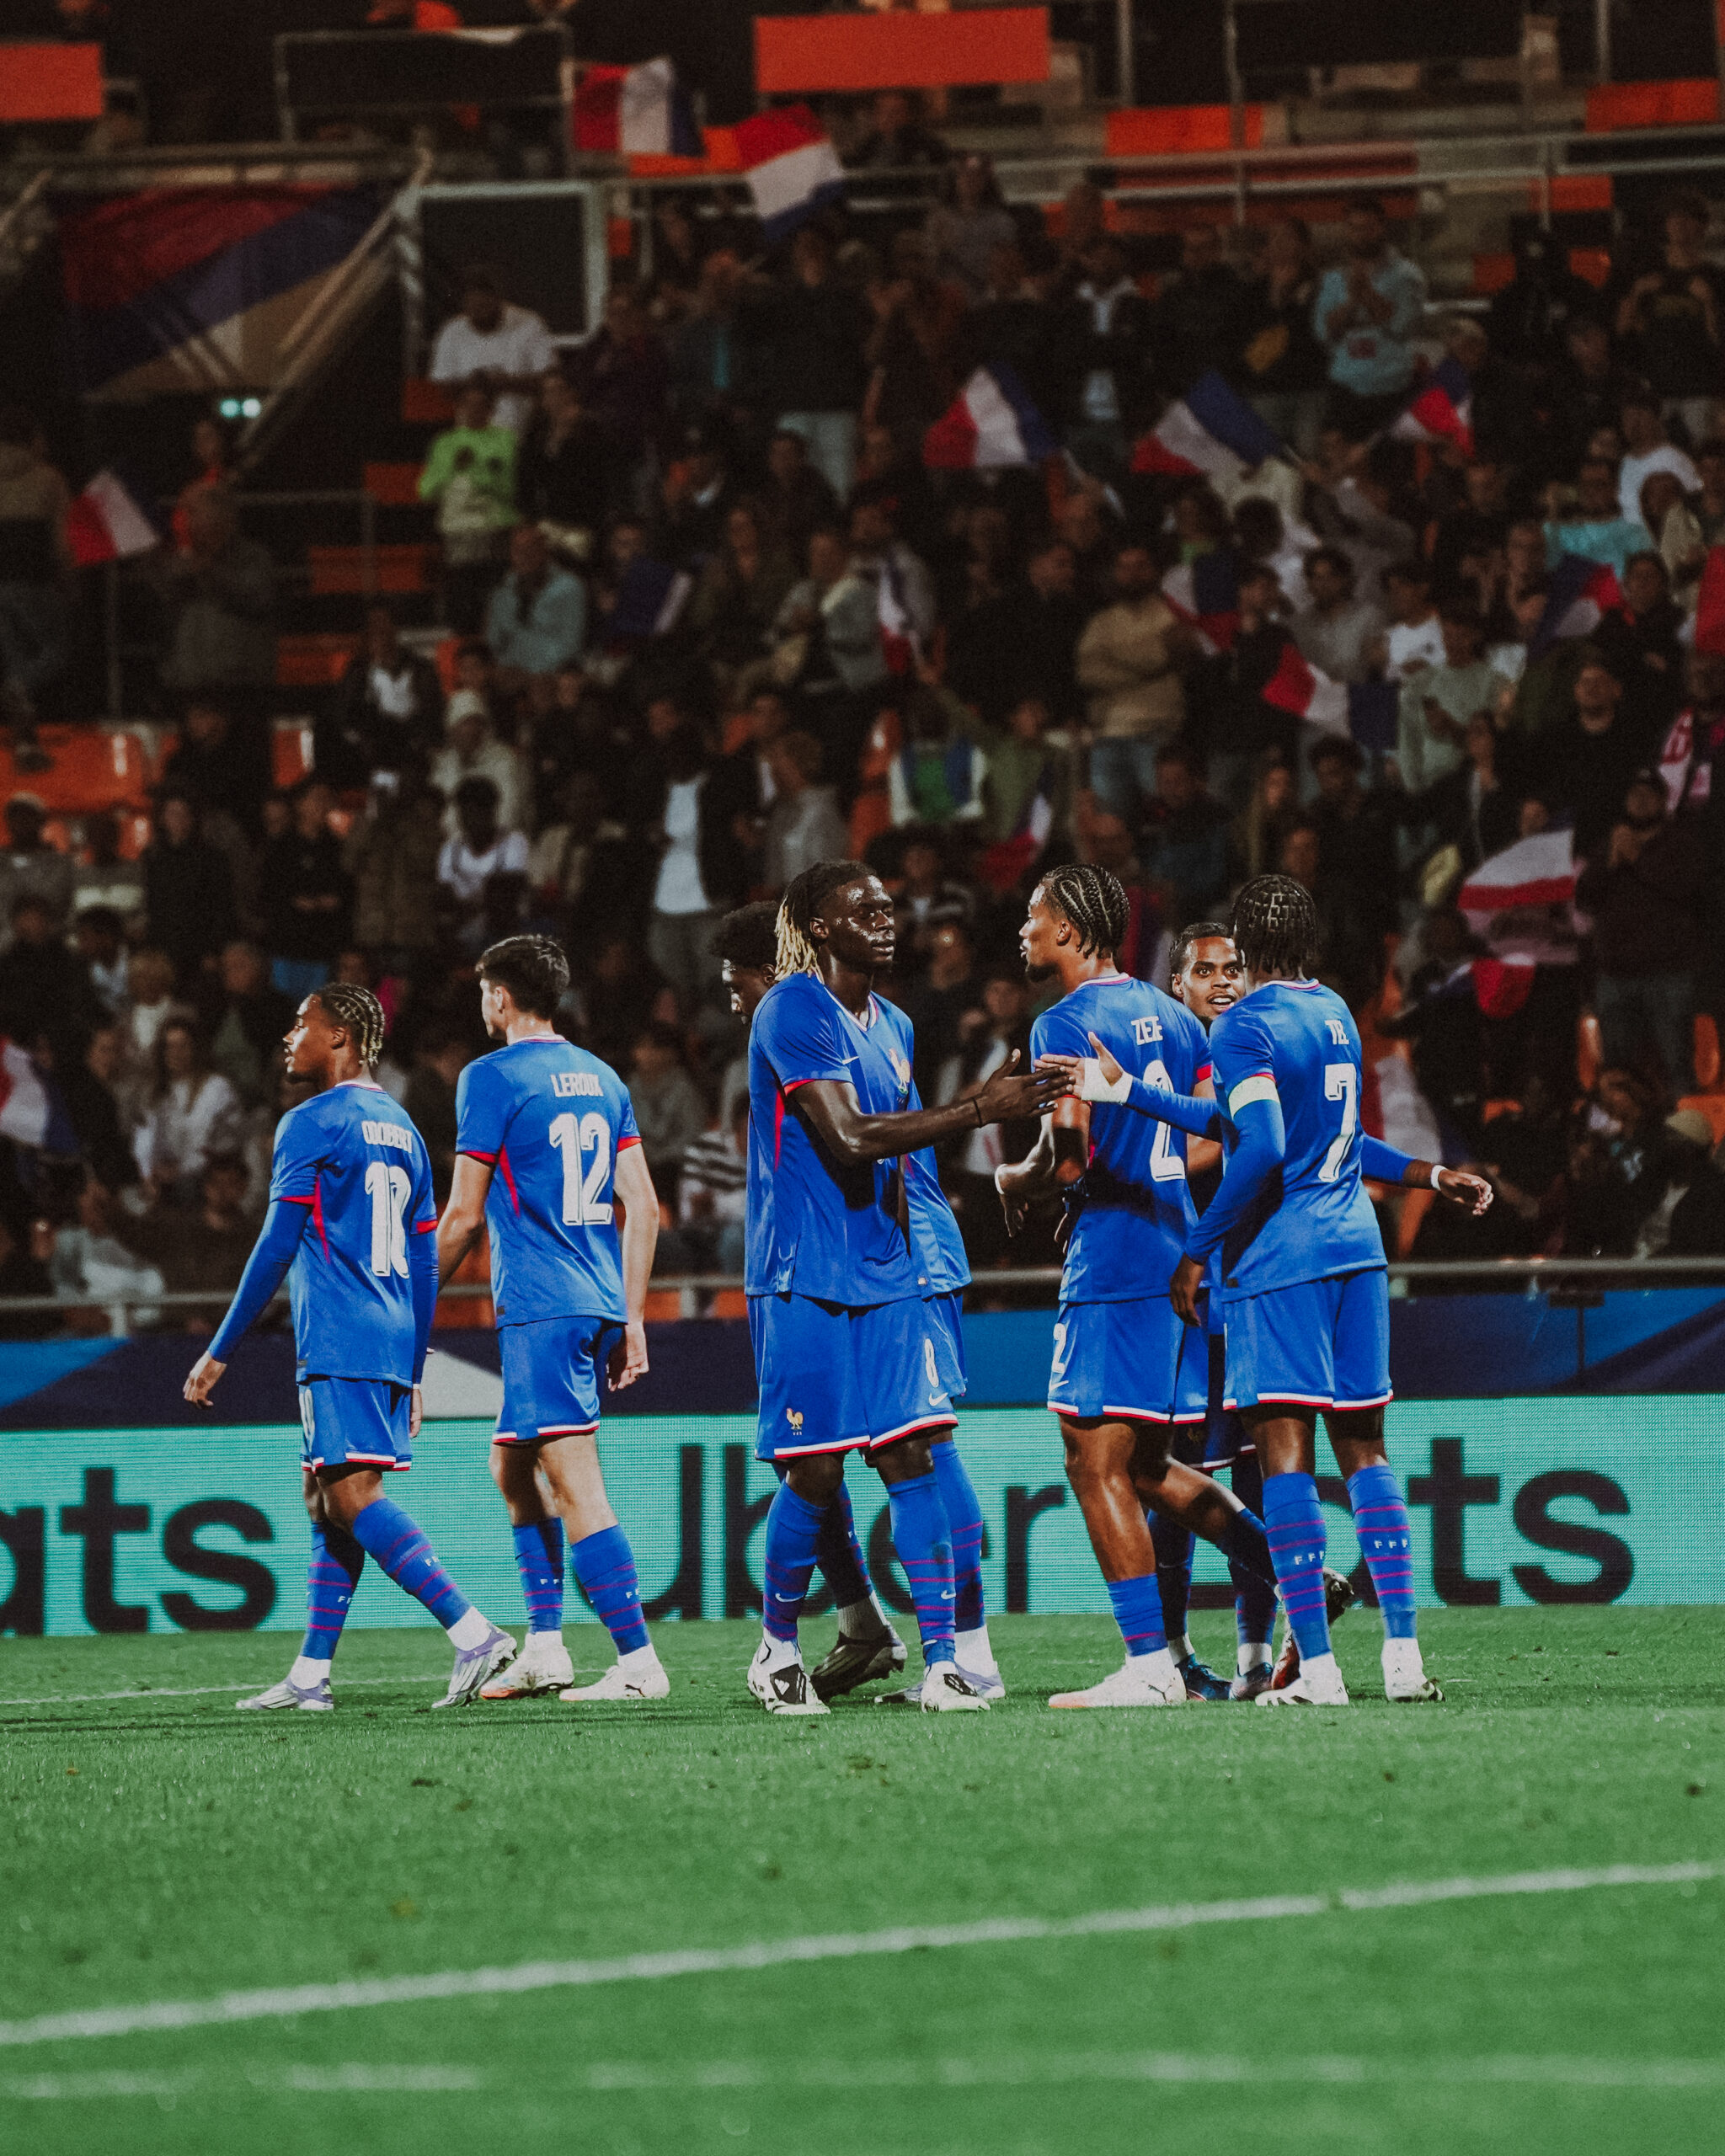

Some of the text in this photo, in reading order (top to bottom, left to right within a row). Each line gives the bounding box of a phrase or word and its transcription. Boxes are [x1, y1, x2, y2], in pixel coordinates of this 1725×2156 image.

[550, 1072, 604, 1097] LEROUX
[1143, 1059, 1186, 1182] 2
[1318, 1063, 1357, 1182] 7
[549, 1113, 612, 1226] 12
